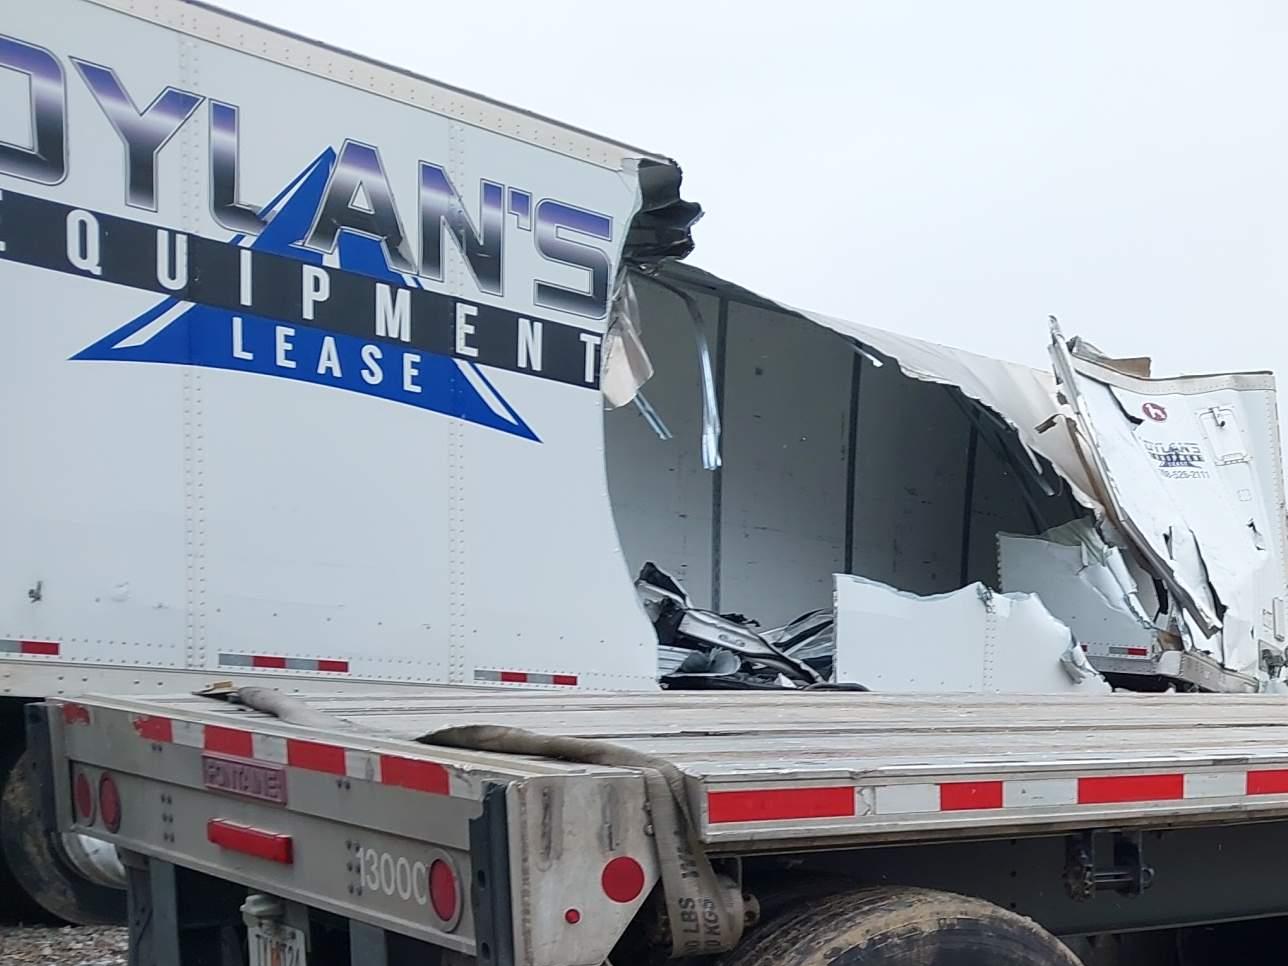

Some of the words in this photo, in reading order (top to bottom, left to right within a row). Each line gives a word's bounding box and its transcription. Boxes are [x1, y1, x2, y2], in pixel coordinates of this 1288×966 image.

[0, 190, 601, 384] QUIPMENT
[232, 316, 422, 394] LEASE
[678, 896, 699, 934] LBS
